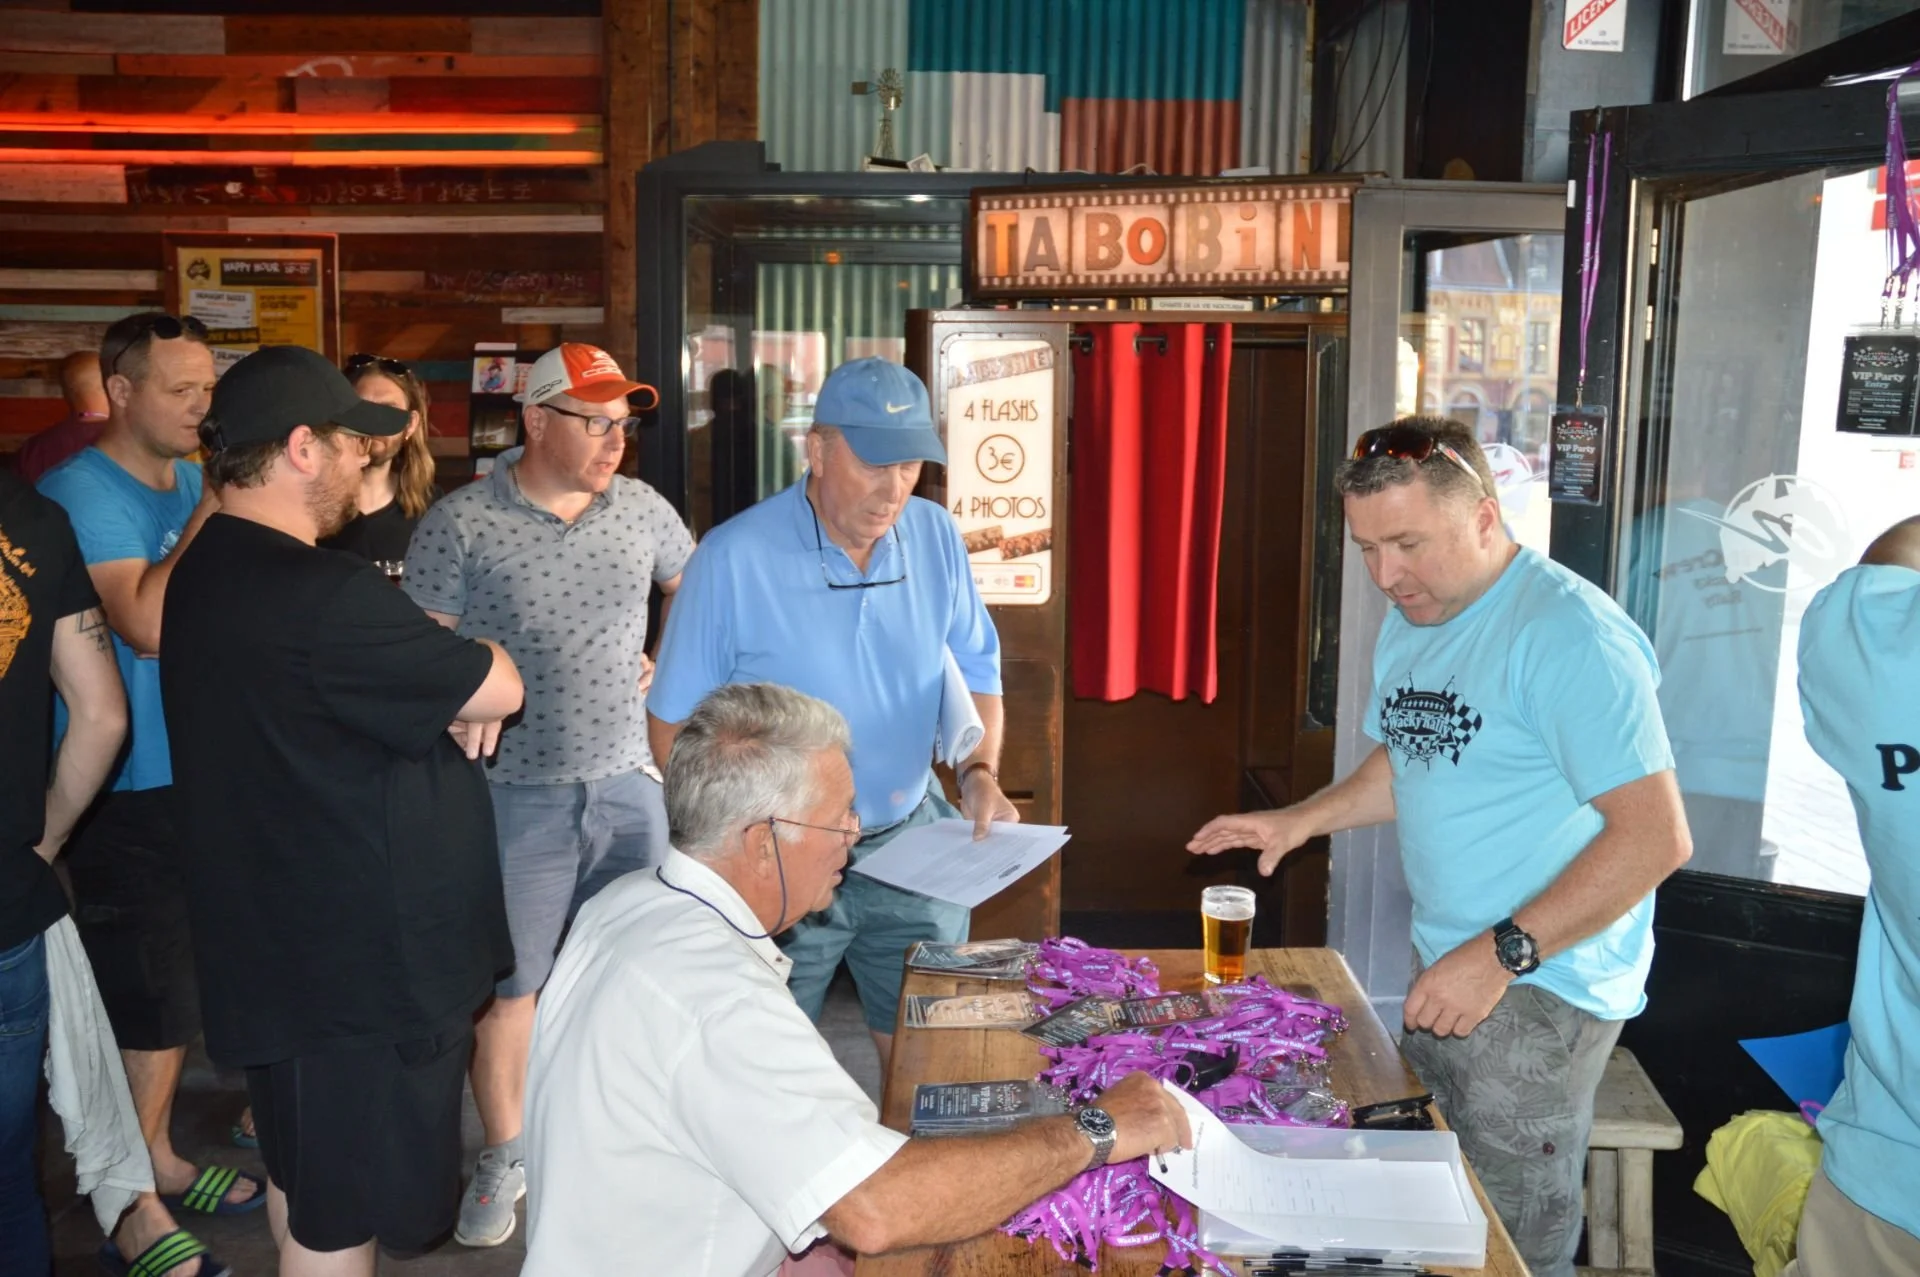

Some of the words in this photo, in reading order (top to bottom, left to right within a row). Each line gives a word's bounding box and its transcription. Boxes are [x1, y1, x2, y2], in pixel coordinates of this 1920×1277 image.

[223, 262, 251, 272] HAPPY
[253, 262, 280, 273] HOUR
[1852, 371, 1873, 380] VIP
[1875, 372, 1906, 383] Party
[1864, 380, 1890, 389] Entry
[964, 400, 974, 421] 4
[982, 399, 1039, 421] FLASHS
[1556, 444, 1571, 452] VIP
[1573, 445, 1596, 454] Party
[988, 446, 1015, 470] 3€
[952, 497, 963, 519] 4
[970, 496, 1046, 519] PHOTOS
[1389, 714, 1421, 730] Wacky
[1423, 715, 1451, 738] Rally
[1190, 1042, 1206, 1051] Rally
[1270, 1038, 1288, 1047] Wacky
[1289, 1041, 1305, 1050] Rally
[1116, 1236, 1141, 1245] Wacky
[1143, 1232, 1161, 1241] Rally
